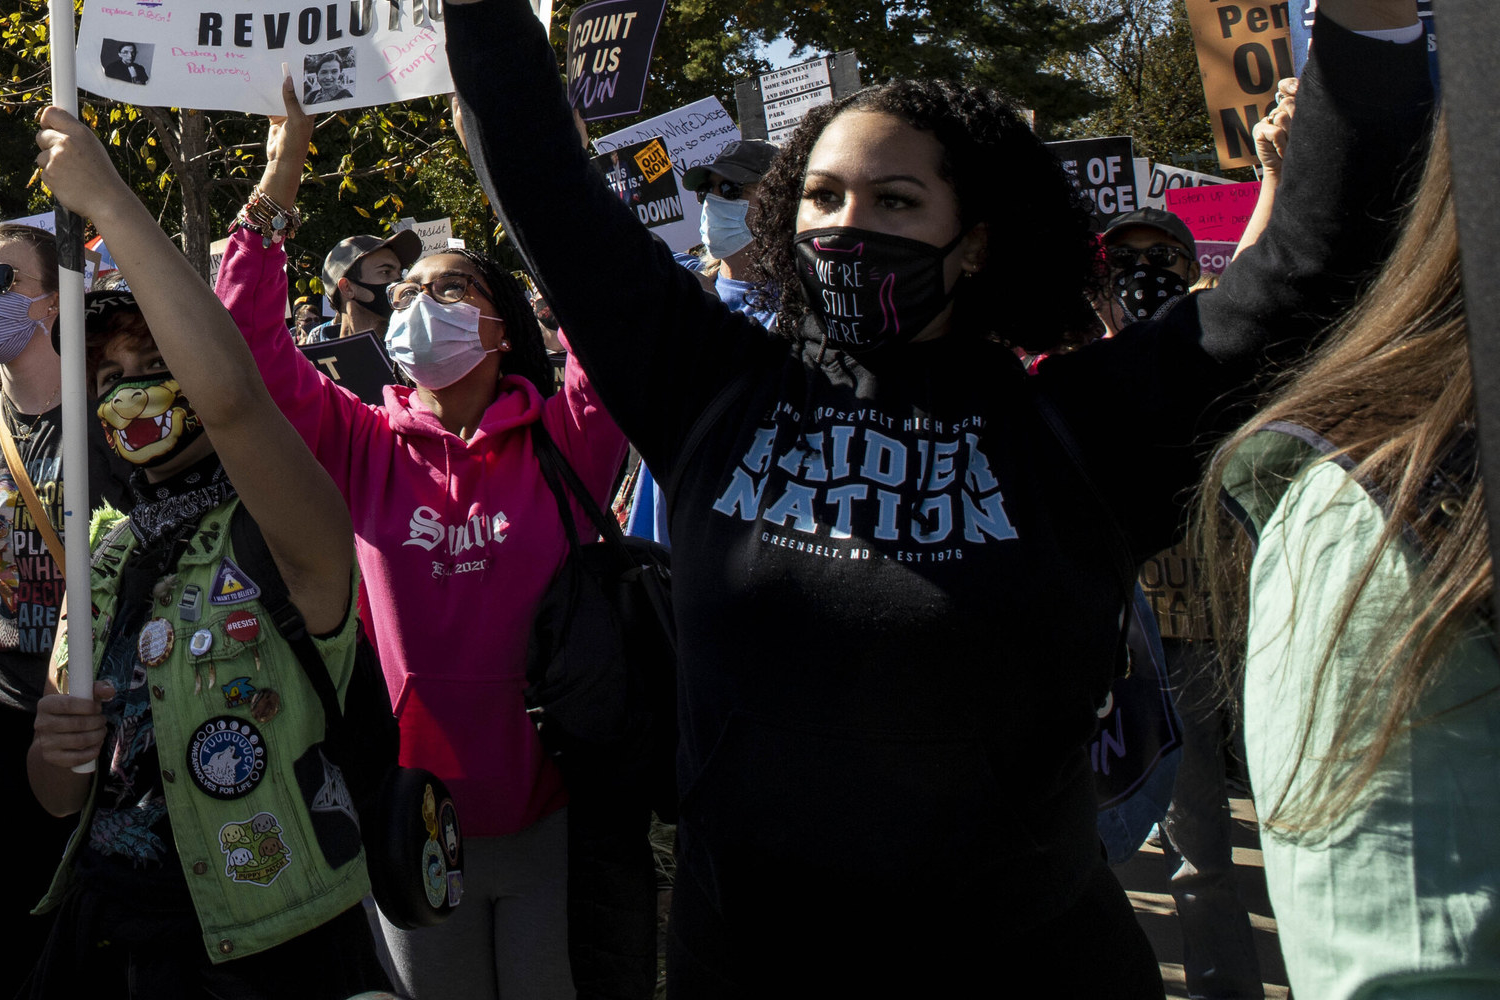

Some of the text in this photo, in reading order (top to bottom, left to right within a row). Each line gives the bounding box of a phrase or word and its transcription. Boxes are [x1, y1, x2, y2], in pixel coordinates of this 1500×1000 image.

[572, 12, 638, 53] COUNT
[225, 51, 247, 60] the
[592, 46, 622, 75] US
[642, 148, 663, 168] OUT
[644, 156, 669, 179] NOW
[1086, 155, 1121, 186] OF
[637, 195, 683, 225] DOWN
[815, 258, 864, 288] WE'RE
[822, 289, 864, 317] STILL
[903, 416, 943, 434] HIGH
[712, 466, 1020, 545] NATION
[850, 548, 870, 560] MD
[897, 550, 922, 563] EST
[931, 549, 963, 563] 1976
[18, 602, 57, 628] ARE
[226, 618, 258, 632] #RESIST
[219, 786, 235, 795] FOR
[237, 780, 253, 793] LIFE
[238, 860, 286, 880] PUPPY PATCH
